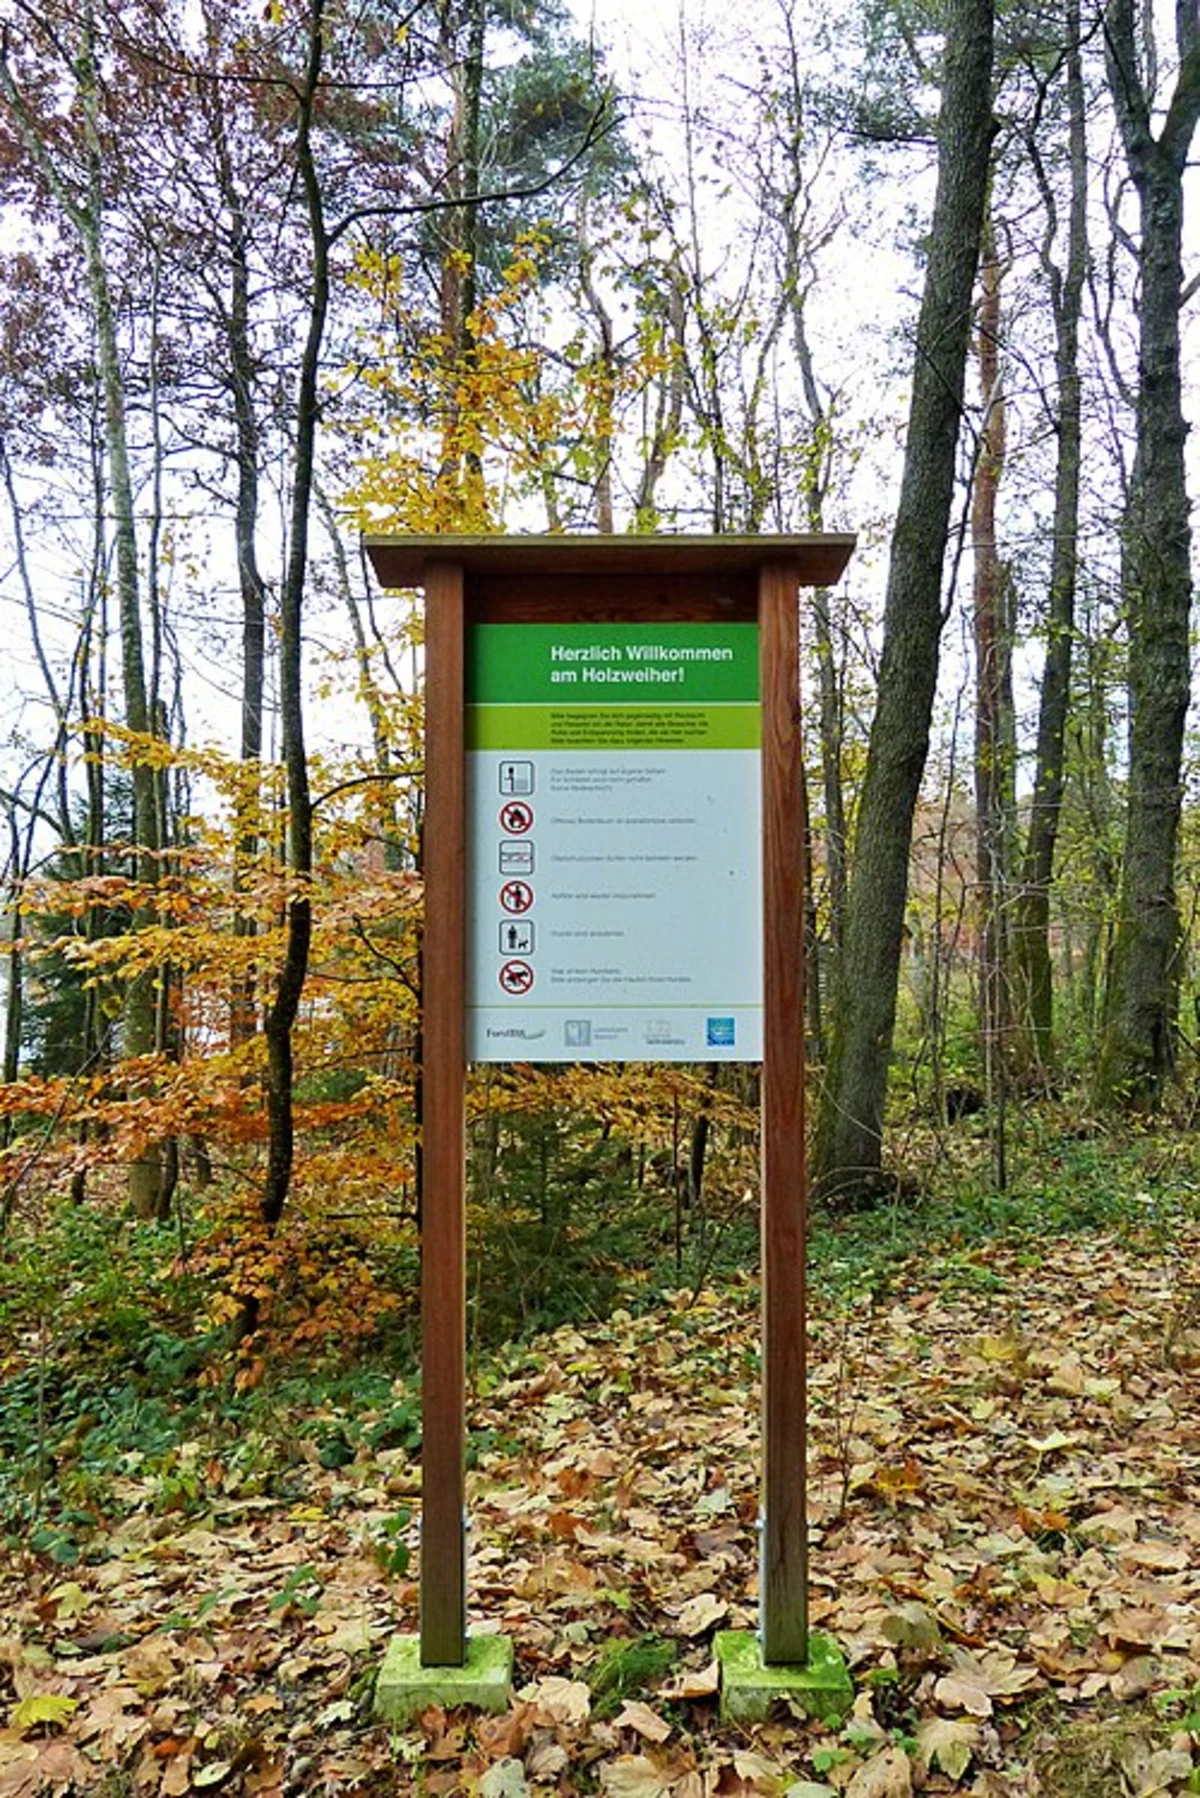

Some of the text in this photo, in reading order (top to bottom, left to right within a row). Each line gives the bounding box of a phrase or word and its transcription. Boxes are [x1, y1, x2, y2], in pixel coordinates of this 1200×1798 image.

[550, 646, 733, 662] Herzlich Willkommen
[550, 667, 685, 683] am Holzweiher!
